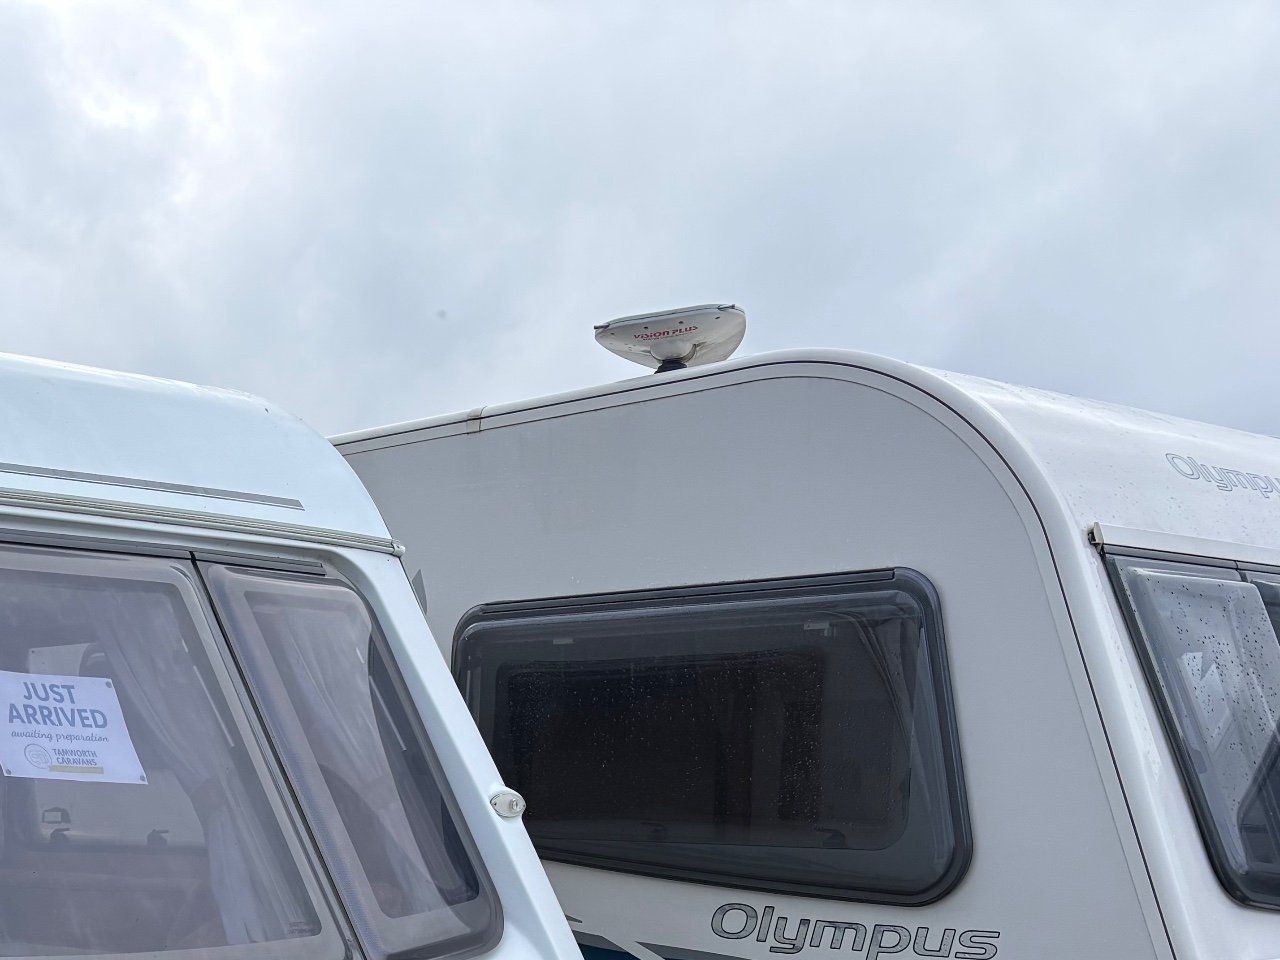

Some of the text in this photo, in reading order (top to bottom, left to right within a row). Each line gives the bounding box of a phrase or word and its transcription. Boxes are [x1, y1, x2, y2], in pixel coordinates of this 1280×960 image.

[23, 682, 76, 705] JUST
[8, 703, 108, 729] ARRIVED
[11, 729, 110, 743] awaiting preparation
[52, 748, 98, 758] TAMWORTH
[56, 757, 98, 766] CARAVANS
